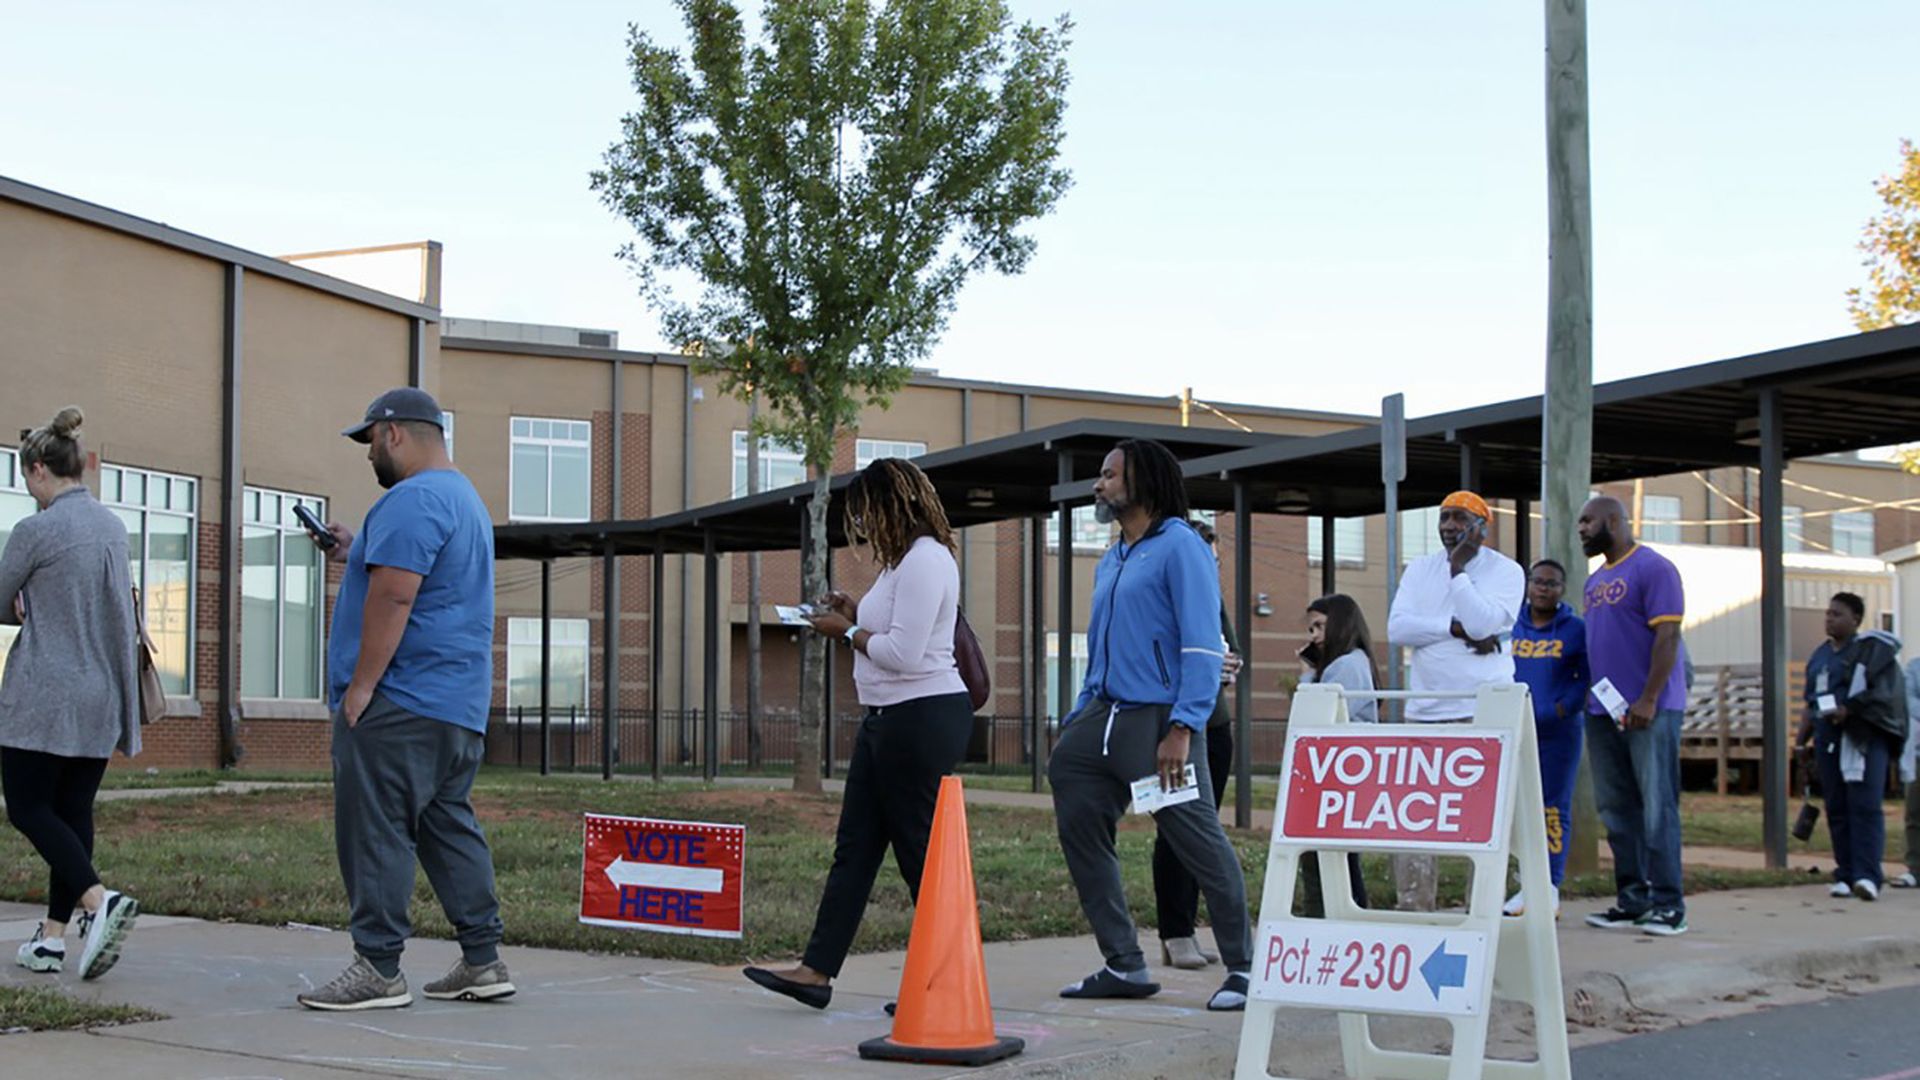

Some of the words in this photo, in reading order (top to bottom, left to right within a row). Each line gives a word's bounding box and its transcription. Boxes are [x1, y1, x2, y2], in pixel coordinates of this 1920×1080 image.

[1511, 639, 1563, 658] 1922
[1307, 745, 1486, 787] VOTING
[1316, 790, 1464, 832] PLACE
[624, 830, 707, 865] VOTE
[618, 887, 704, 924] HERE
